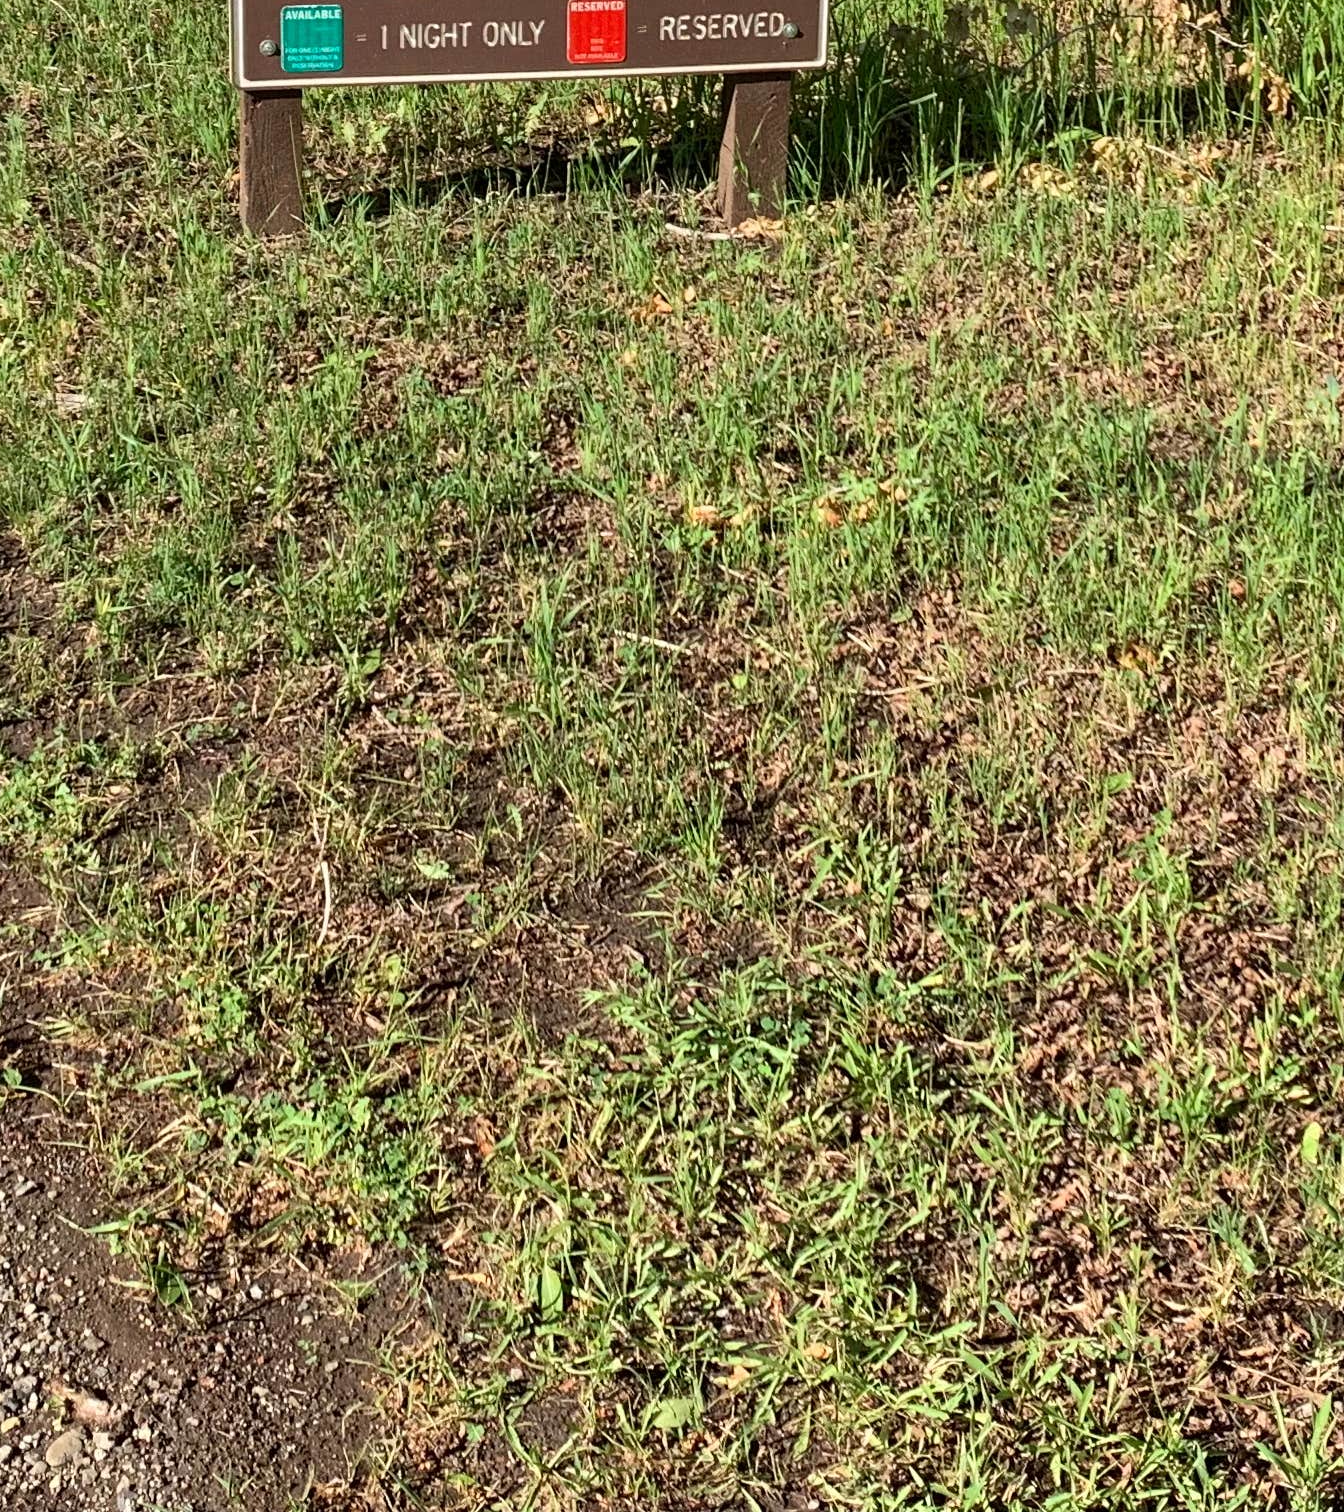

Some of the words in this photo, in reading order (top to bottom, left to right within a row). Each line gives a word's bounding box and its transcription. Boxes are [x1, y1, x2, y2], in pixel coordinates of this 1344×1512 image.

[285, 9, 343, 20] AVAILABLE
[570, 0, 625, 12] RESERVED
[380, 24, 388, 50] 1
[399, 21, 473, 49] NIGHT
[482, 19, 545, 48] ONLY
[659, 11, 784, 41] RESERVED
